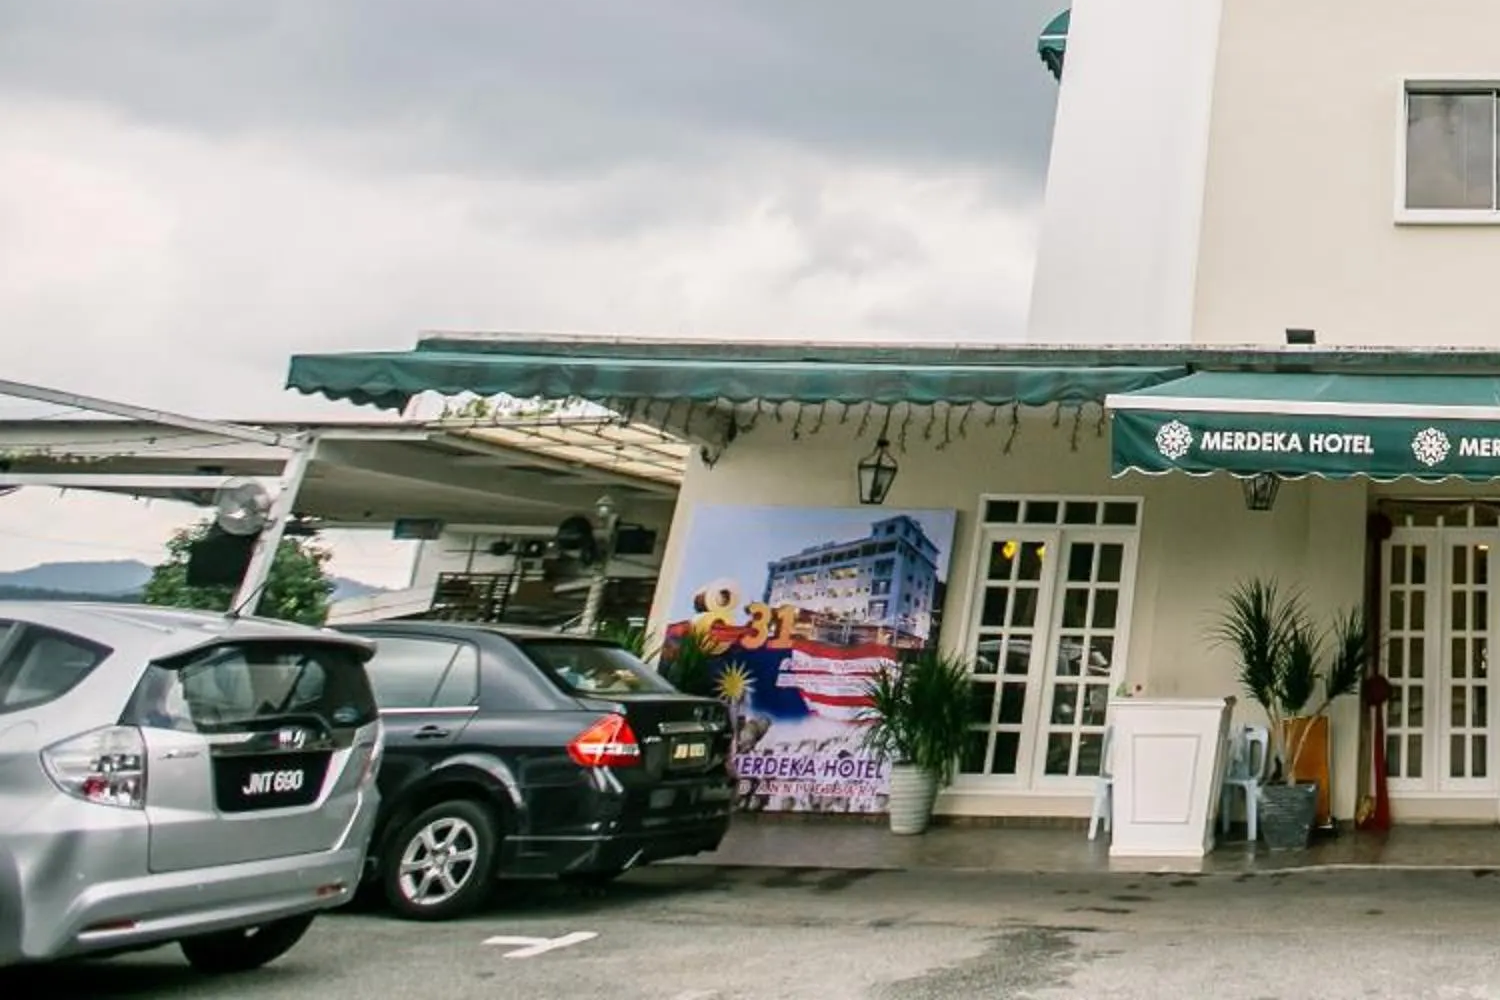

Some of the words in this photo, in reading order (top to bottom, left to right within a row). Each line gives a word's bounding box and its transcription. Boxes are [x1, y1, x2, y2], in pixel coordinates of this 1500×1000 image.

[1200, 430, 1303, 453] MERDEKA
[1308, 433, 1375, 455] HOTEL
[824, 759, 883, 779] HOTEL
[242, 772, 274, 795] JNT
[274, 769, 304, 792] 690
